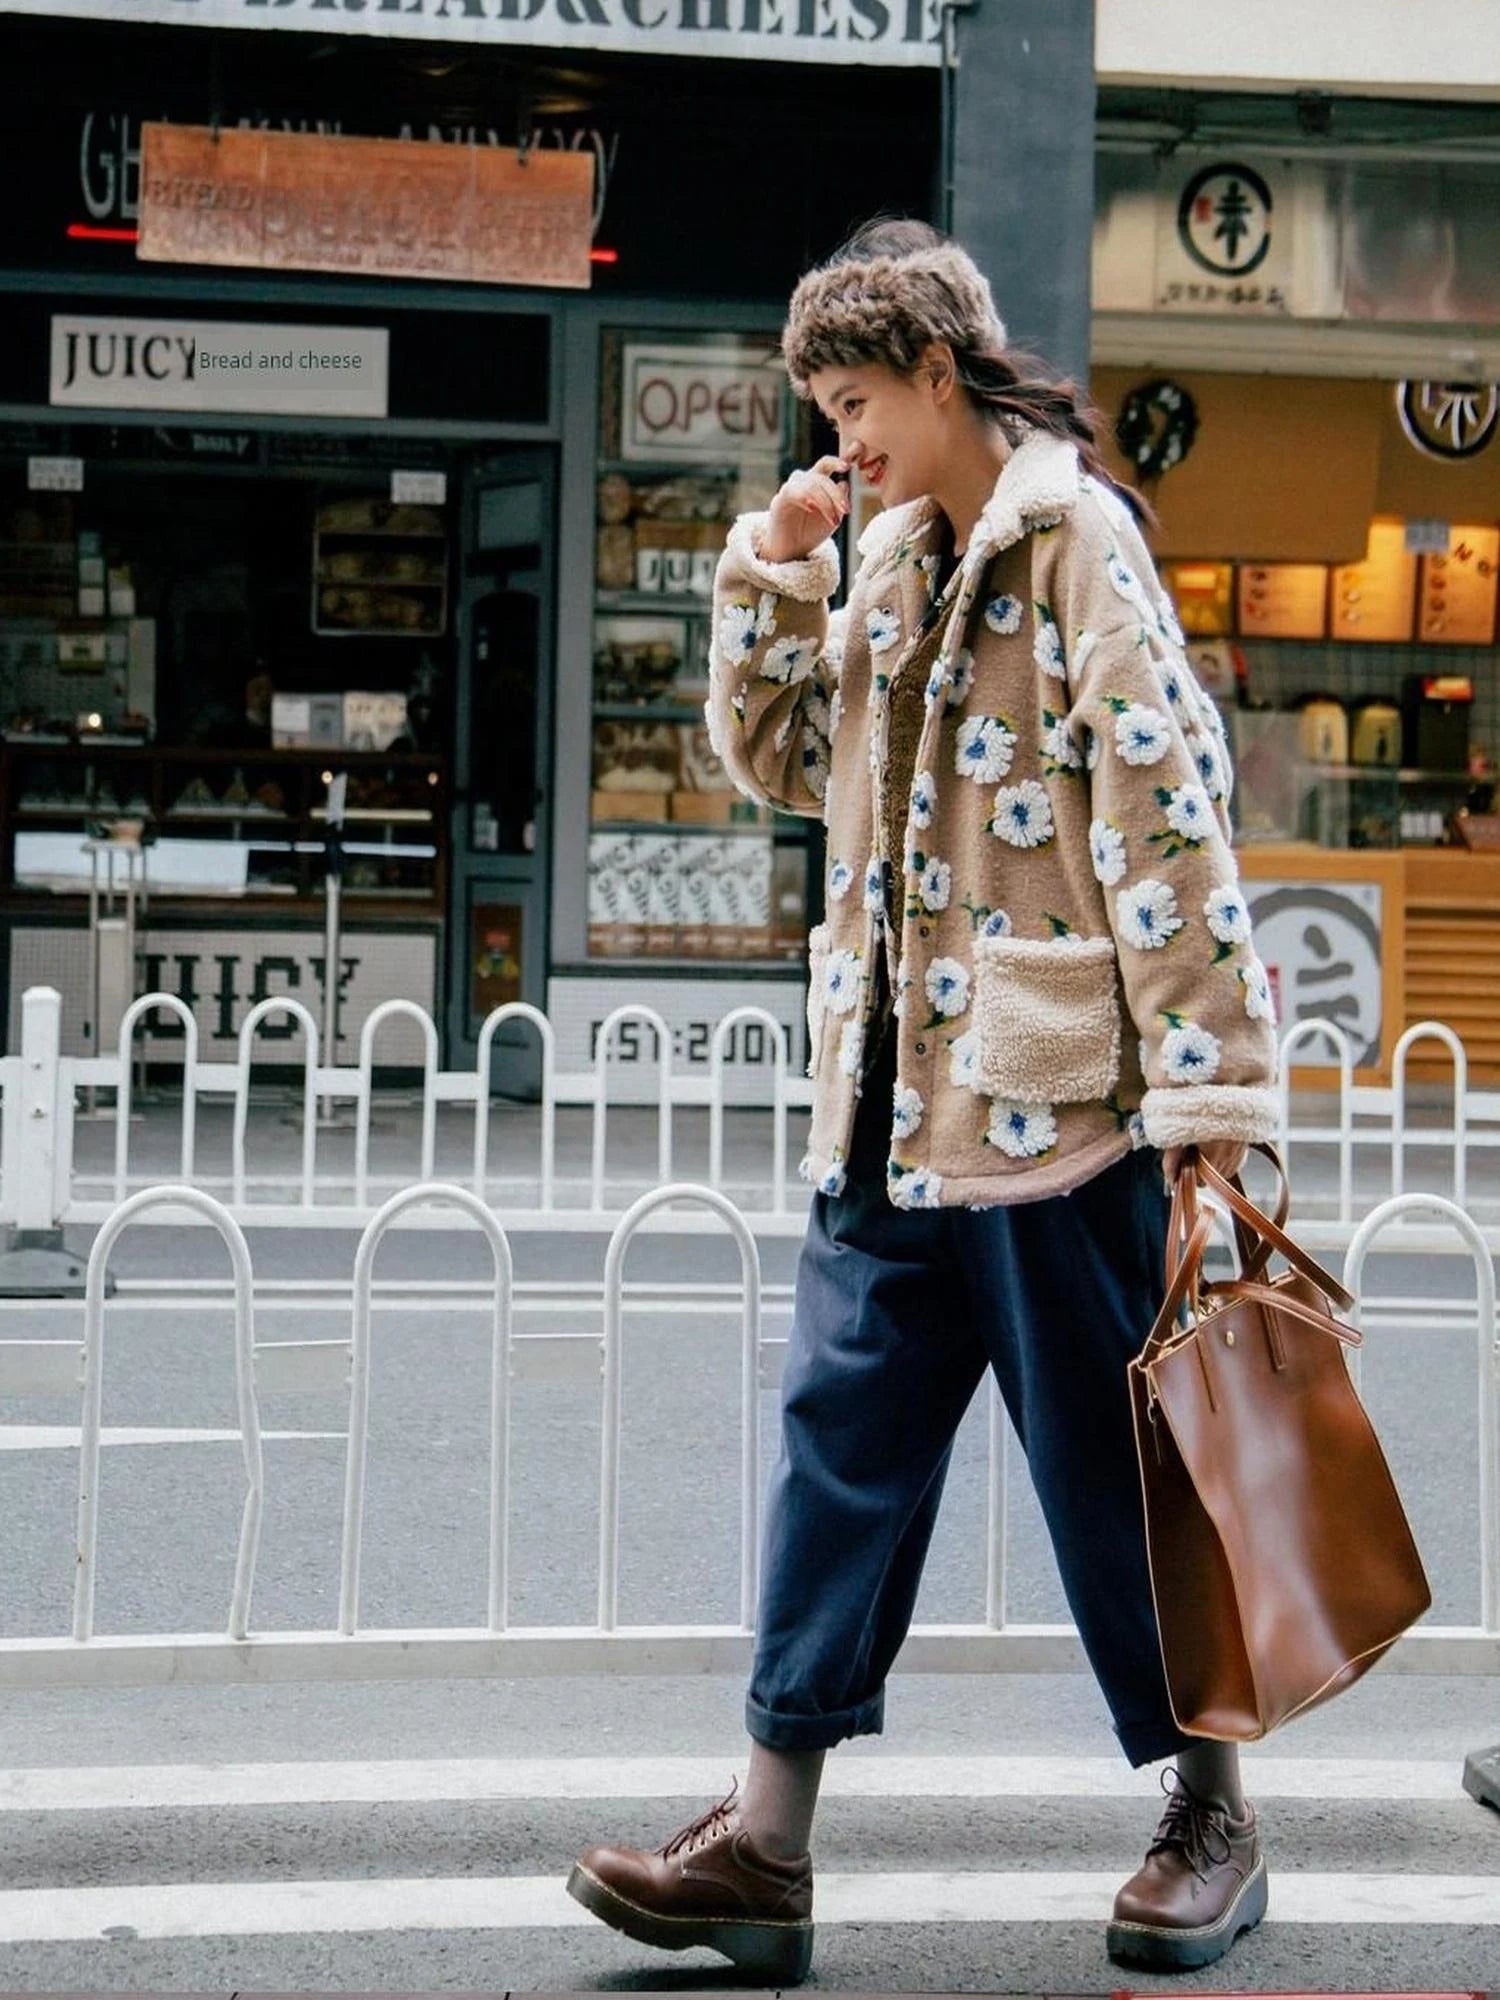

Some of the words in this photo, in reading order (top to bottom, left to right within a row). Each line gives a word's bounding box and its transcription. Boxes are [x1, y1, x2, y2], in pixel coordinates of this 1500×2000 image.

[243, 0, 944, 43] CHEESE
[63, 332, 196, 388] JUICY
[639, 378, 780, 435] OPEN
[133, 954, 360, 1040] UICY
